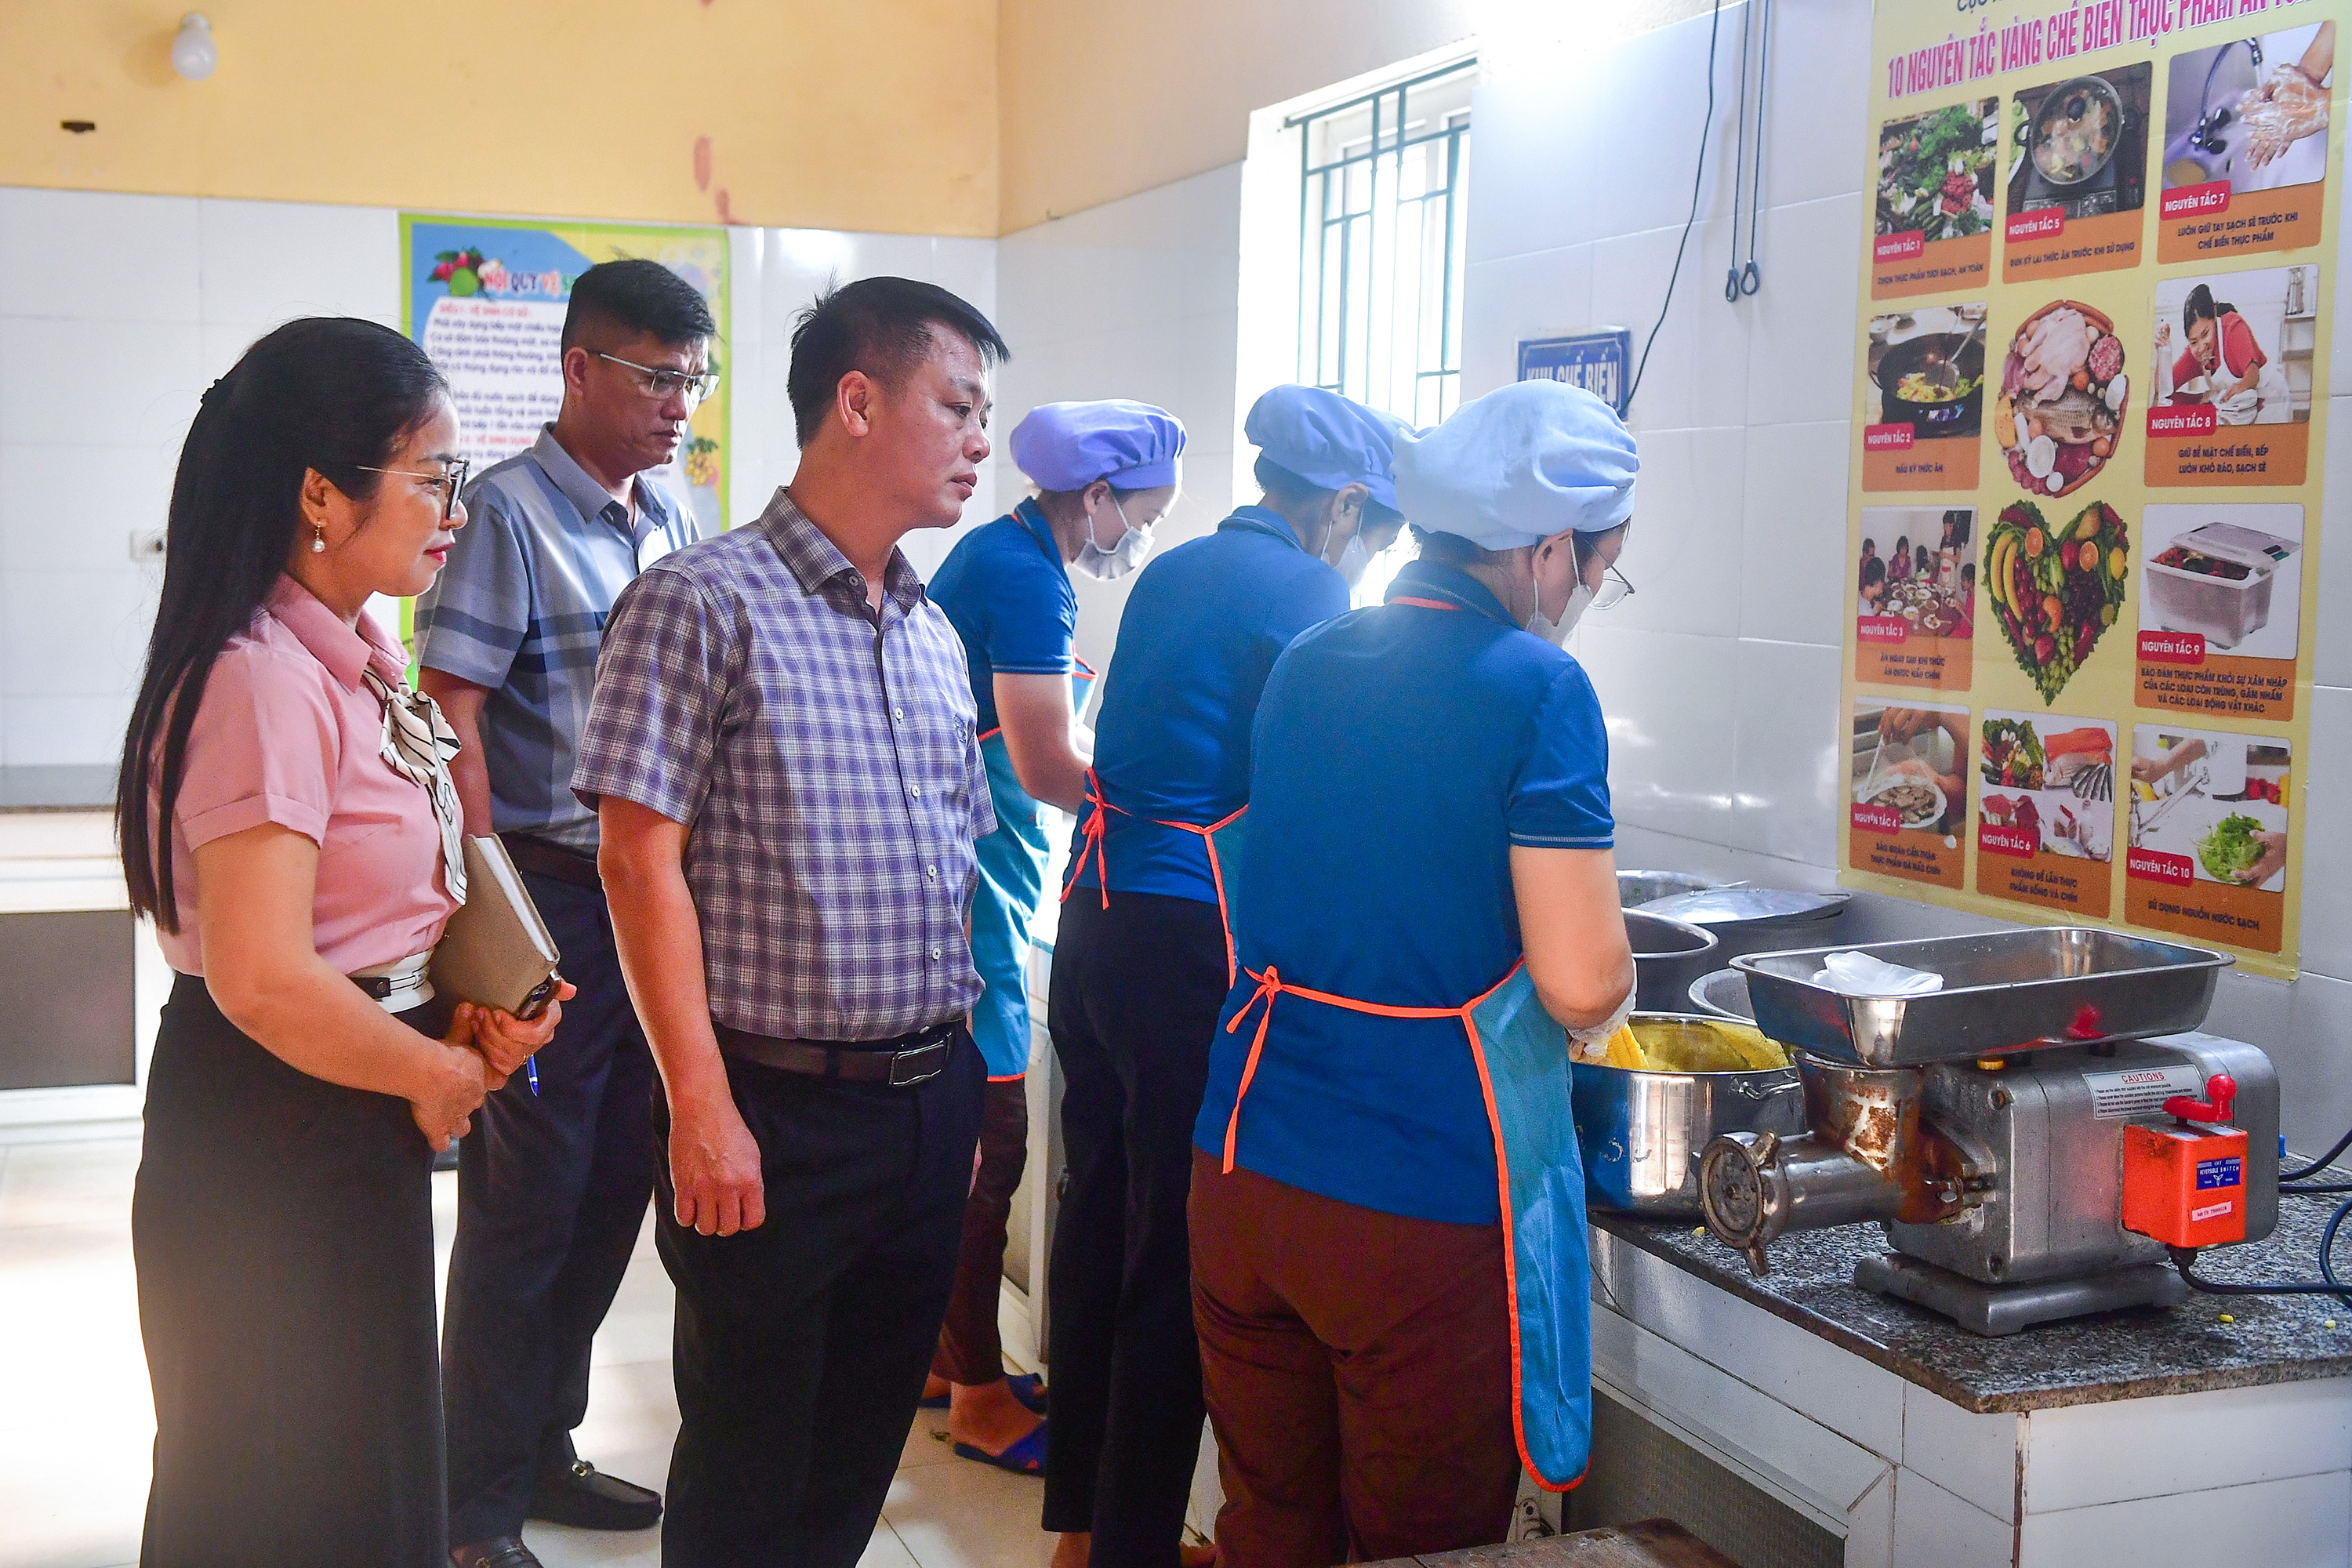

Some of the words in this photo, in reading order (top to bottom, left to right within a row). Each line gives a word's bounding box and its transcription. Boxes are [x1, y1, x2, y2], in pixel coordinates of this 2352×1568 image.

[1888, 56, 1904, 99] 10
[1906, 33, 1965, 93] NGUYÊN
[1969, 15, 1996, 79] TẮC
[2001, 15, 2042, 72] VÀNG
[2046, 0, 2078, 61] CHẾ
[2165, 195, 2198, 212] NGUYÊN
[2200, 191, 2217, 206] TẮC
[2219, 193, 2225, 204] 7
[2009, 220, 2038, 235] NGUYÊN
[2038, 216, 2053, 230] TẮC
[2055, 218, 2060, 229] 5
[2227, 219, 2246, 231] SẠCH
[2285, 212, 2298, 222] KHI
[1877, 241, 1903, 256] NGUYÊN
[1584, 347, 1617, 405] BIẾN
[2151, 416, 2185, 430] NGUYÊN
[2186, 412, 2203, 428] TẮC
[2205, 416, 2211, 427] 8
[1867, 432, 1892, 445] NGUYÊN
[1893, 430, 1904, 443] TẮC
[1906, 434, 1911, 442] 2
[1860, 624, 1885, 635] NGUYÊN
[1886, 622, 1897, 636] TẮC
[1899, 627, 1904, 637] 3
[2142, 639, 2174, 653] NGUYÊN
[2175, 639, 2192, 655] TẮC
[2194, 644, 2200, 655] 9
[1982, 833, 2009, 848] NGUYÊN
[2009, 834, 2024, 850] TẮC
[2025, 840, 2031, 851] 6
[2129, 858, 2161, 873] NGUYÊN
[2161, 860, 2179, 877] TẮC
[2180, 867, 2190, 879] 10
[2122, 1072, 2165, 1083] CAUTIONS
